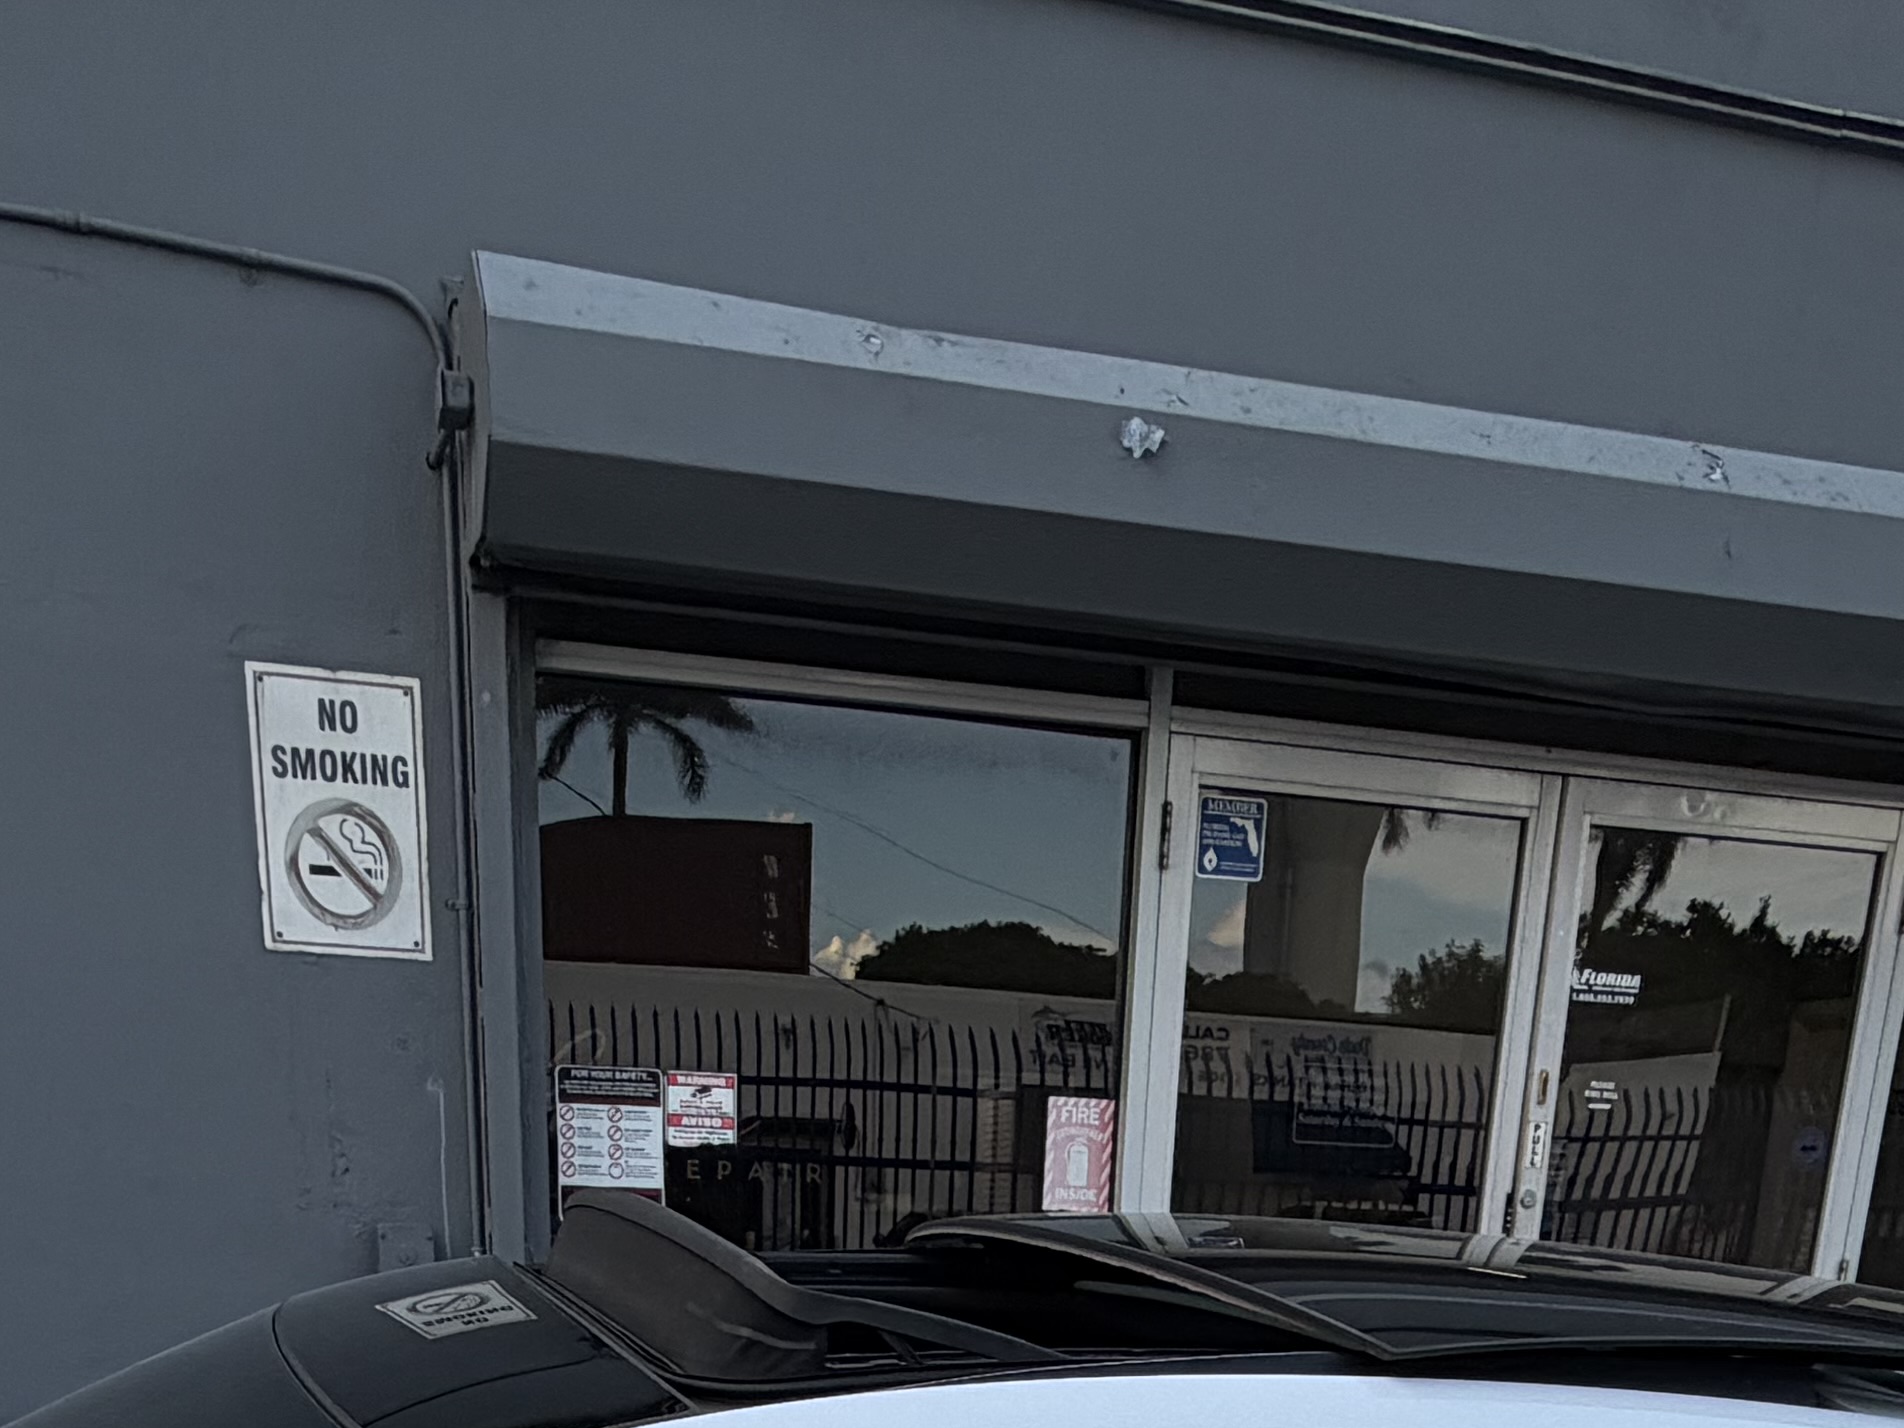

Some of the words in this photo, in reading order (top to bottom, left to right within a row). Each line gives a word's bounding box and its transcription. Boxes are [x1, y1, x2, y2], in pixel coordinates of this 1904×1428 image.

[317, 697, 358, 734] NO
[271, 744, 411, 789] SMOKING
[1580, 968, 1642, 988] FLORIDA
[680, 1115, 723, 1128] AVISO
[1060, 1106, 1101, 1126] FIRE
[1055, 1187, 1098, 1202] INSIDE
